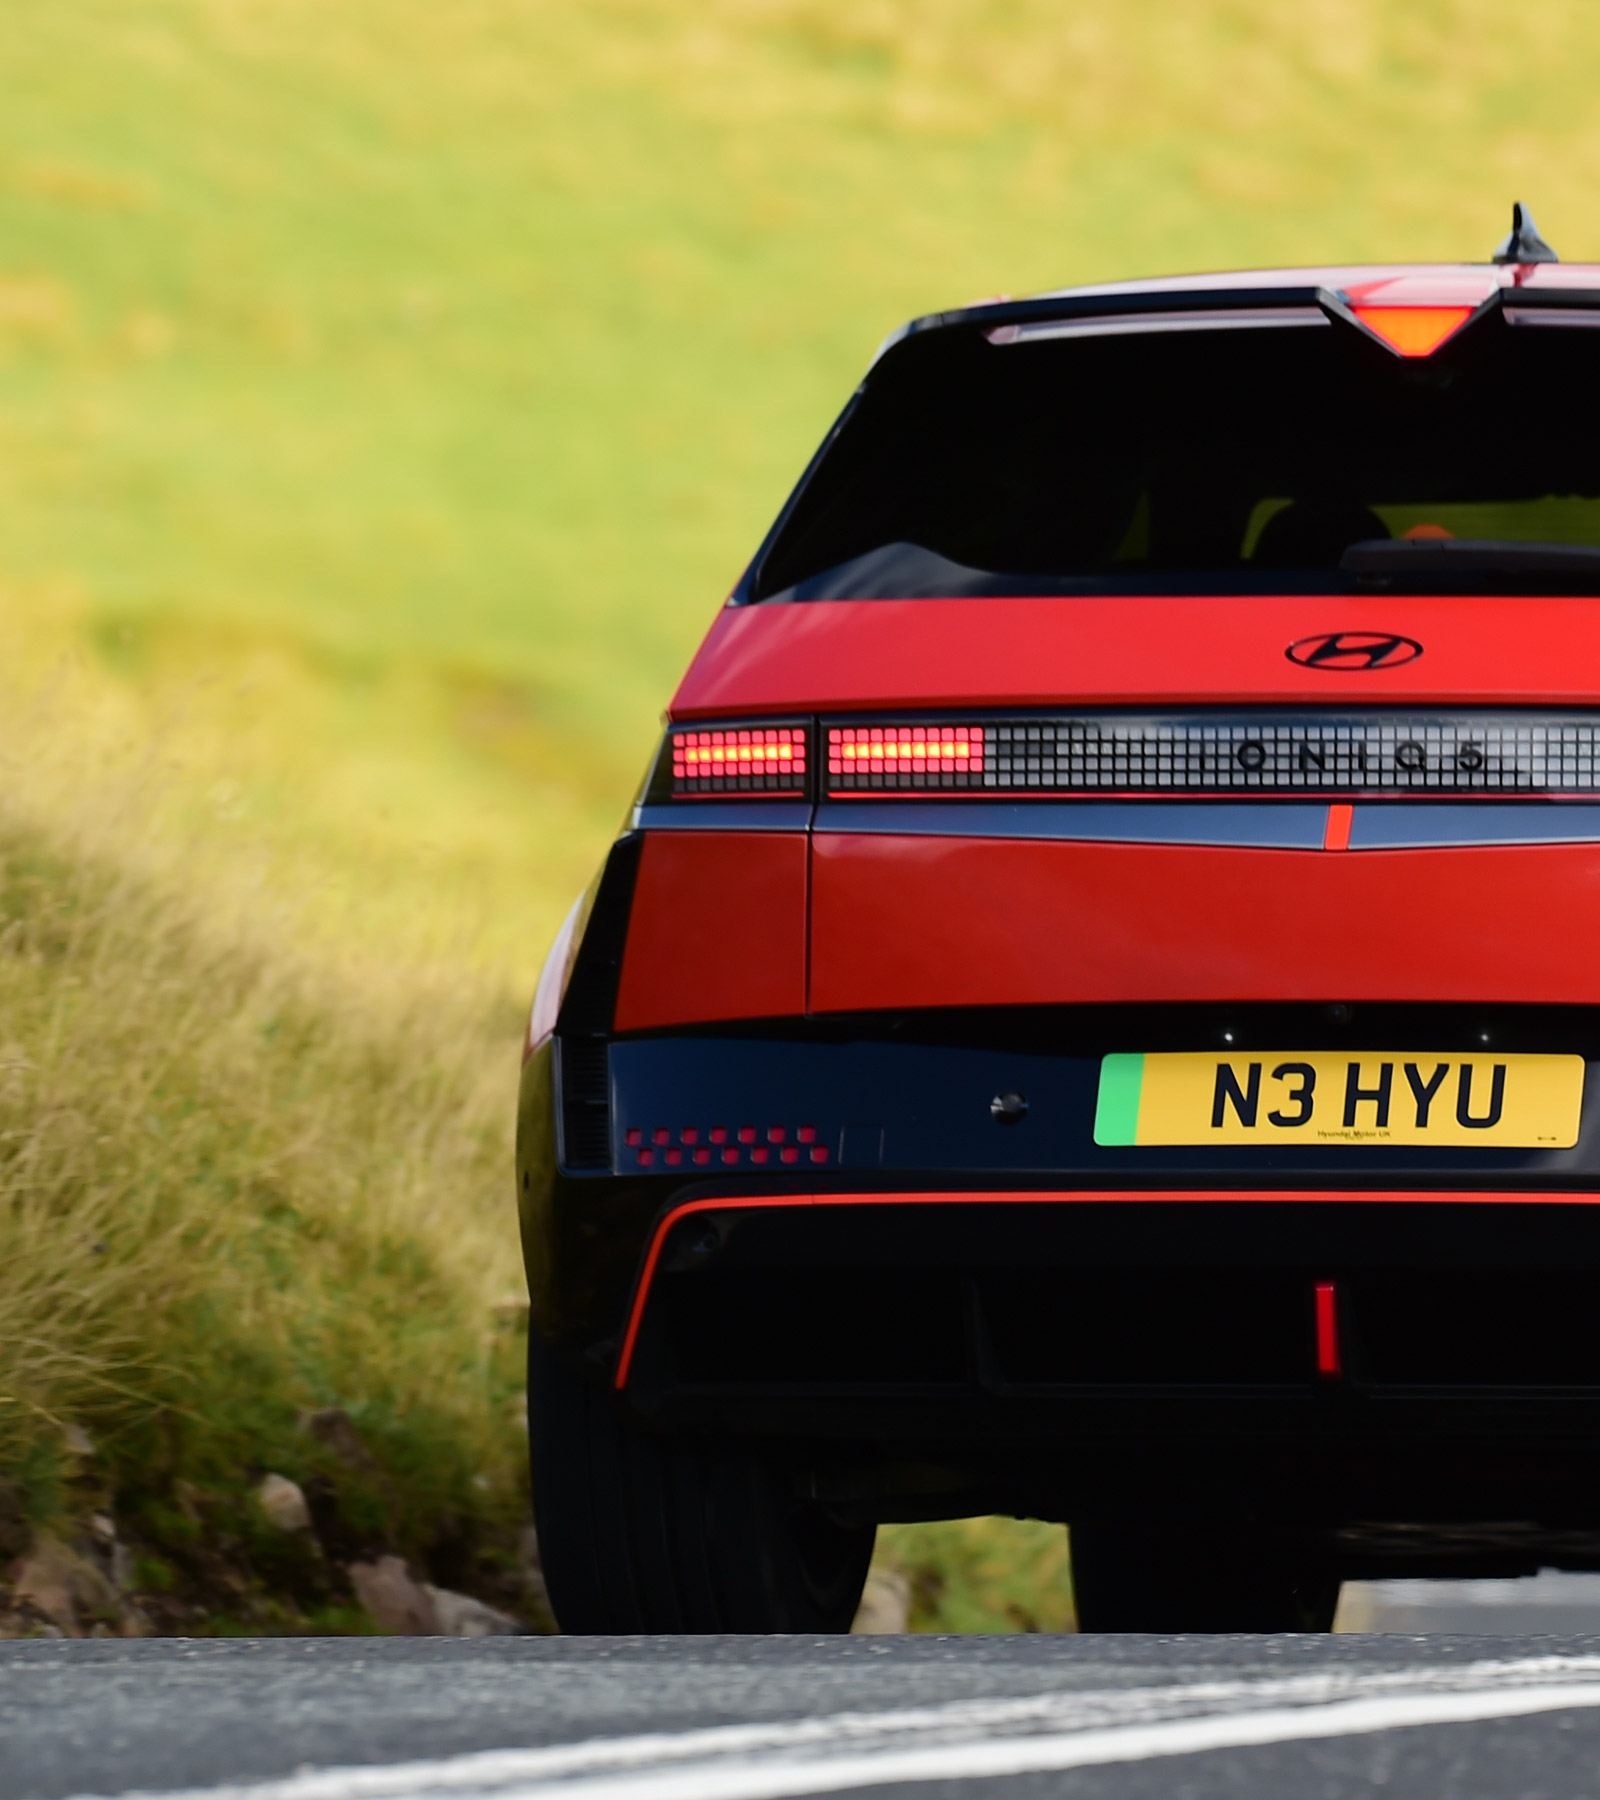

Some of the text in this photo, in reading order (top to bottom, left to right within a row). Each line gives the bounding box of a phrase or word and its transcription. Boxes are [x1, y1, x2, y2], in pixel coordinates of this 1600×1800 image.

[1458, 740, 1484, 773] 5
[1210, 1062, 1507, 1129] N3 HYU
